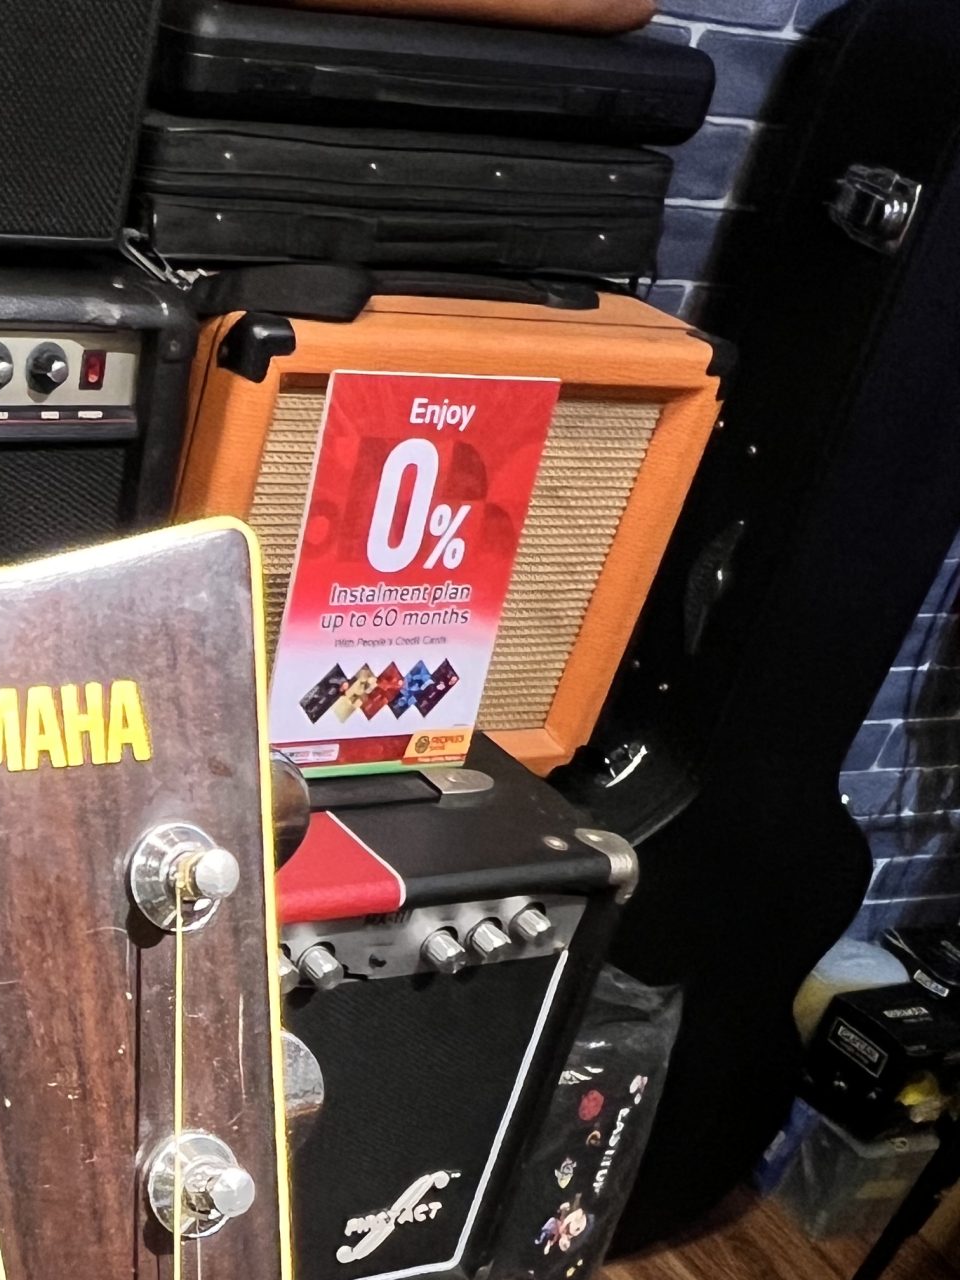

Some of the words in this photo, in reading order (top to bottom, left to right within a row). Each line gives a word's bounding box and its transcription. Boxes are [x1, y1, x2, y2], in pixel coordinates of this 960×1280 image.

[410, 398, 476, 431] Enjoy
[367, 438, 471, 572] 0%
[331, 583, 428, 604] Instalment
[431, 582, 470, 605] plan
[321, 614, 344, 632] up
[349, 612, 366, 627] to
[372, 609, 398, 626] 60
[402, 608, 469, 625] months
